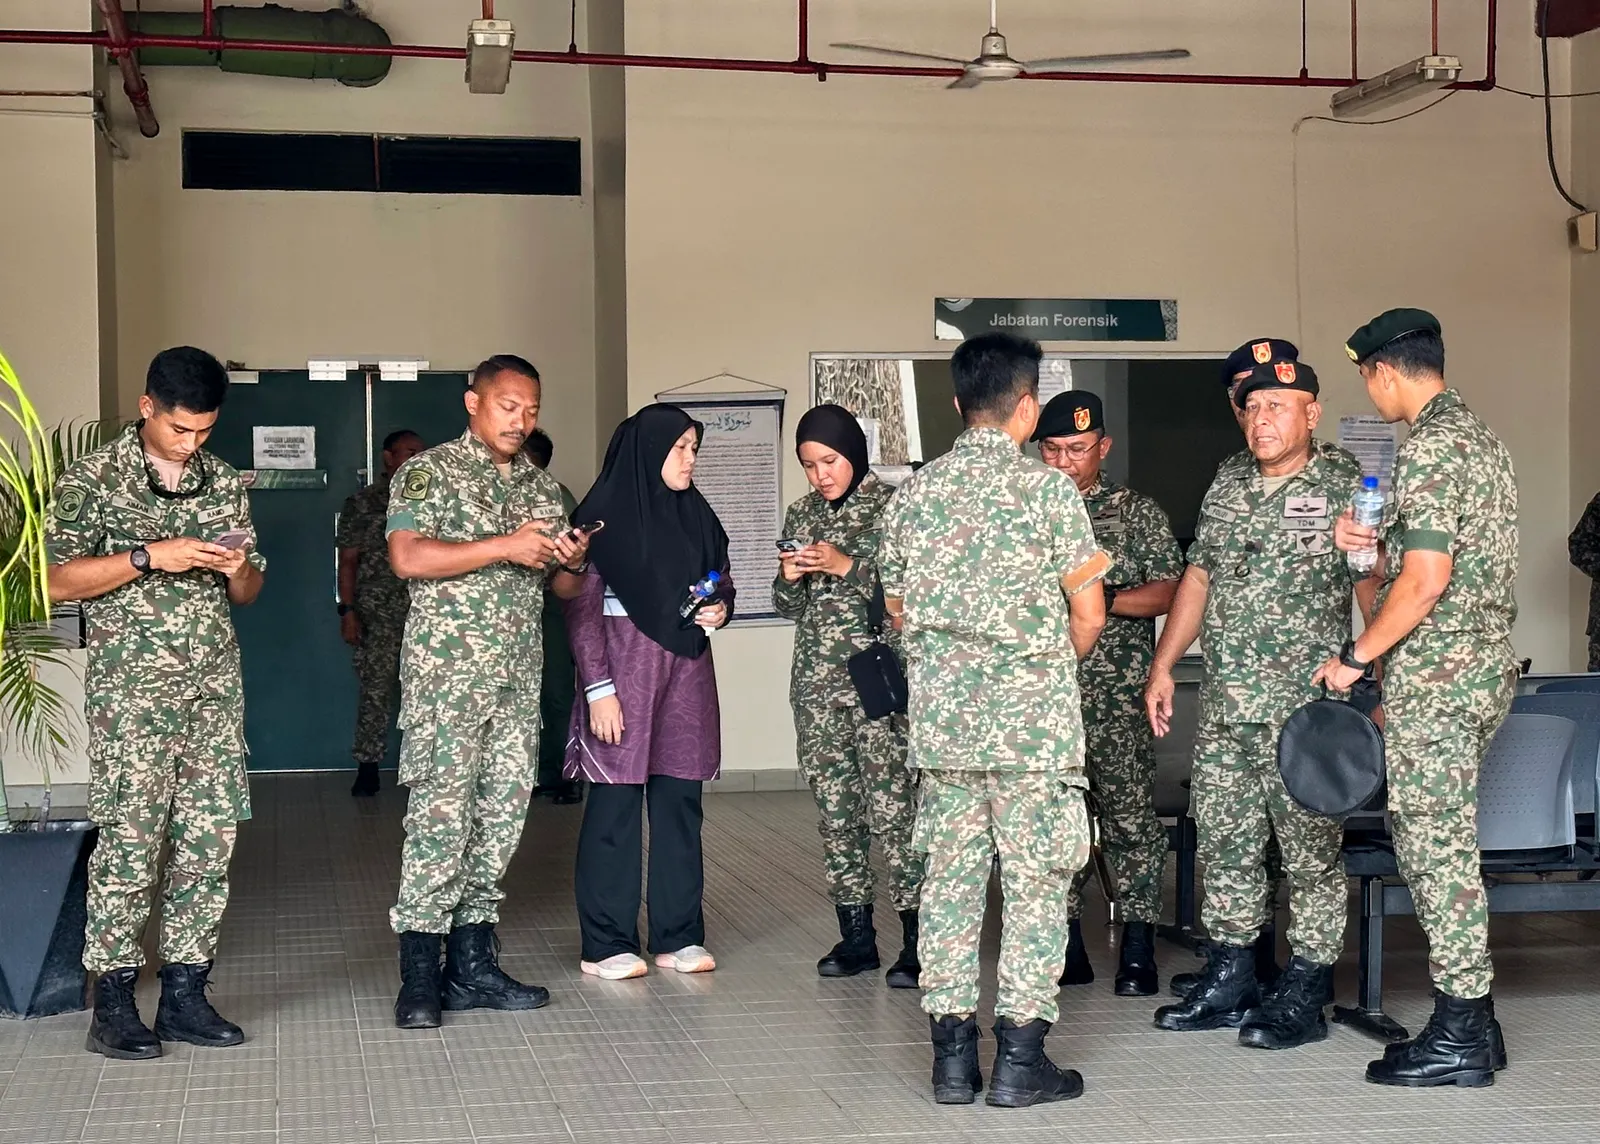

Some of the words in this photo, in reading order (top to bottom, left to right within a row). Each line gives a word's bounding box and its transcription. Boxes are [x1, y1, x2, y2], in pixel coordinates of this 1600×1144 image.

[990, 313, 1049, 327] Jabatan
[1054, 313, 1118, 327] Forensik
[1297, 520, 1315, 528] TDM
